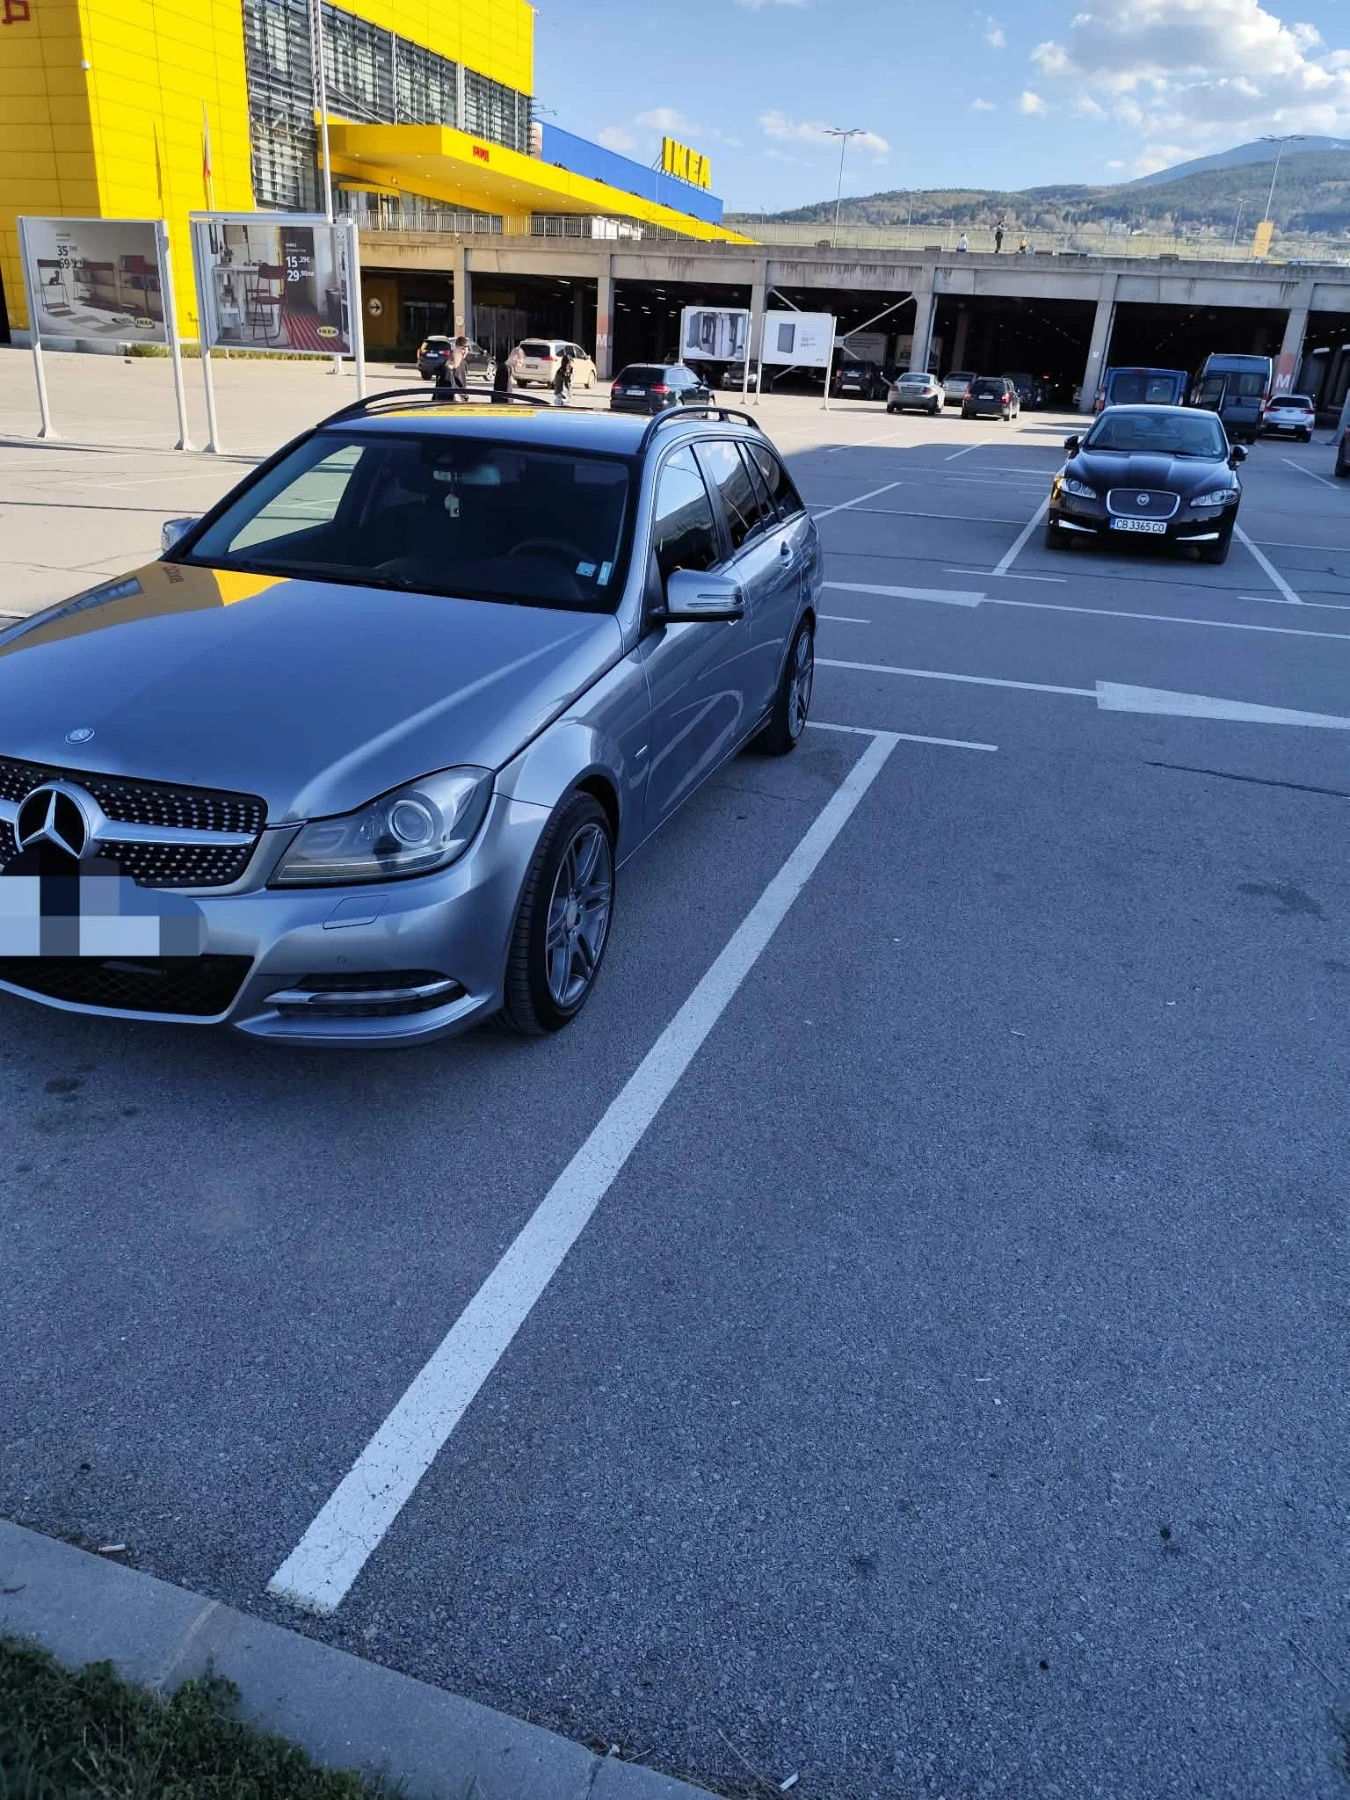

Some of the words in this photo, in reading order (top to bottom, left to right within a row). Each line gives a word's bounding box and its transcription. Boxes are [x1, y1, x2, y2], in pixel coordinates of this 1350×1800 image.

[662, 136, 711, 190] IKEA
[597, 334, 607, 346] M
[1275, 374, 1291, 388] M
[1116, 519, 1128, 529] CB
[1129, 520, 1151, 531] 3365
